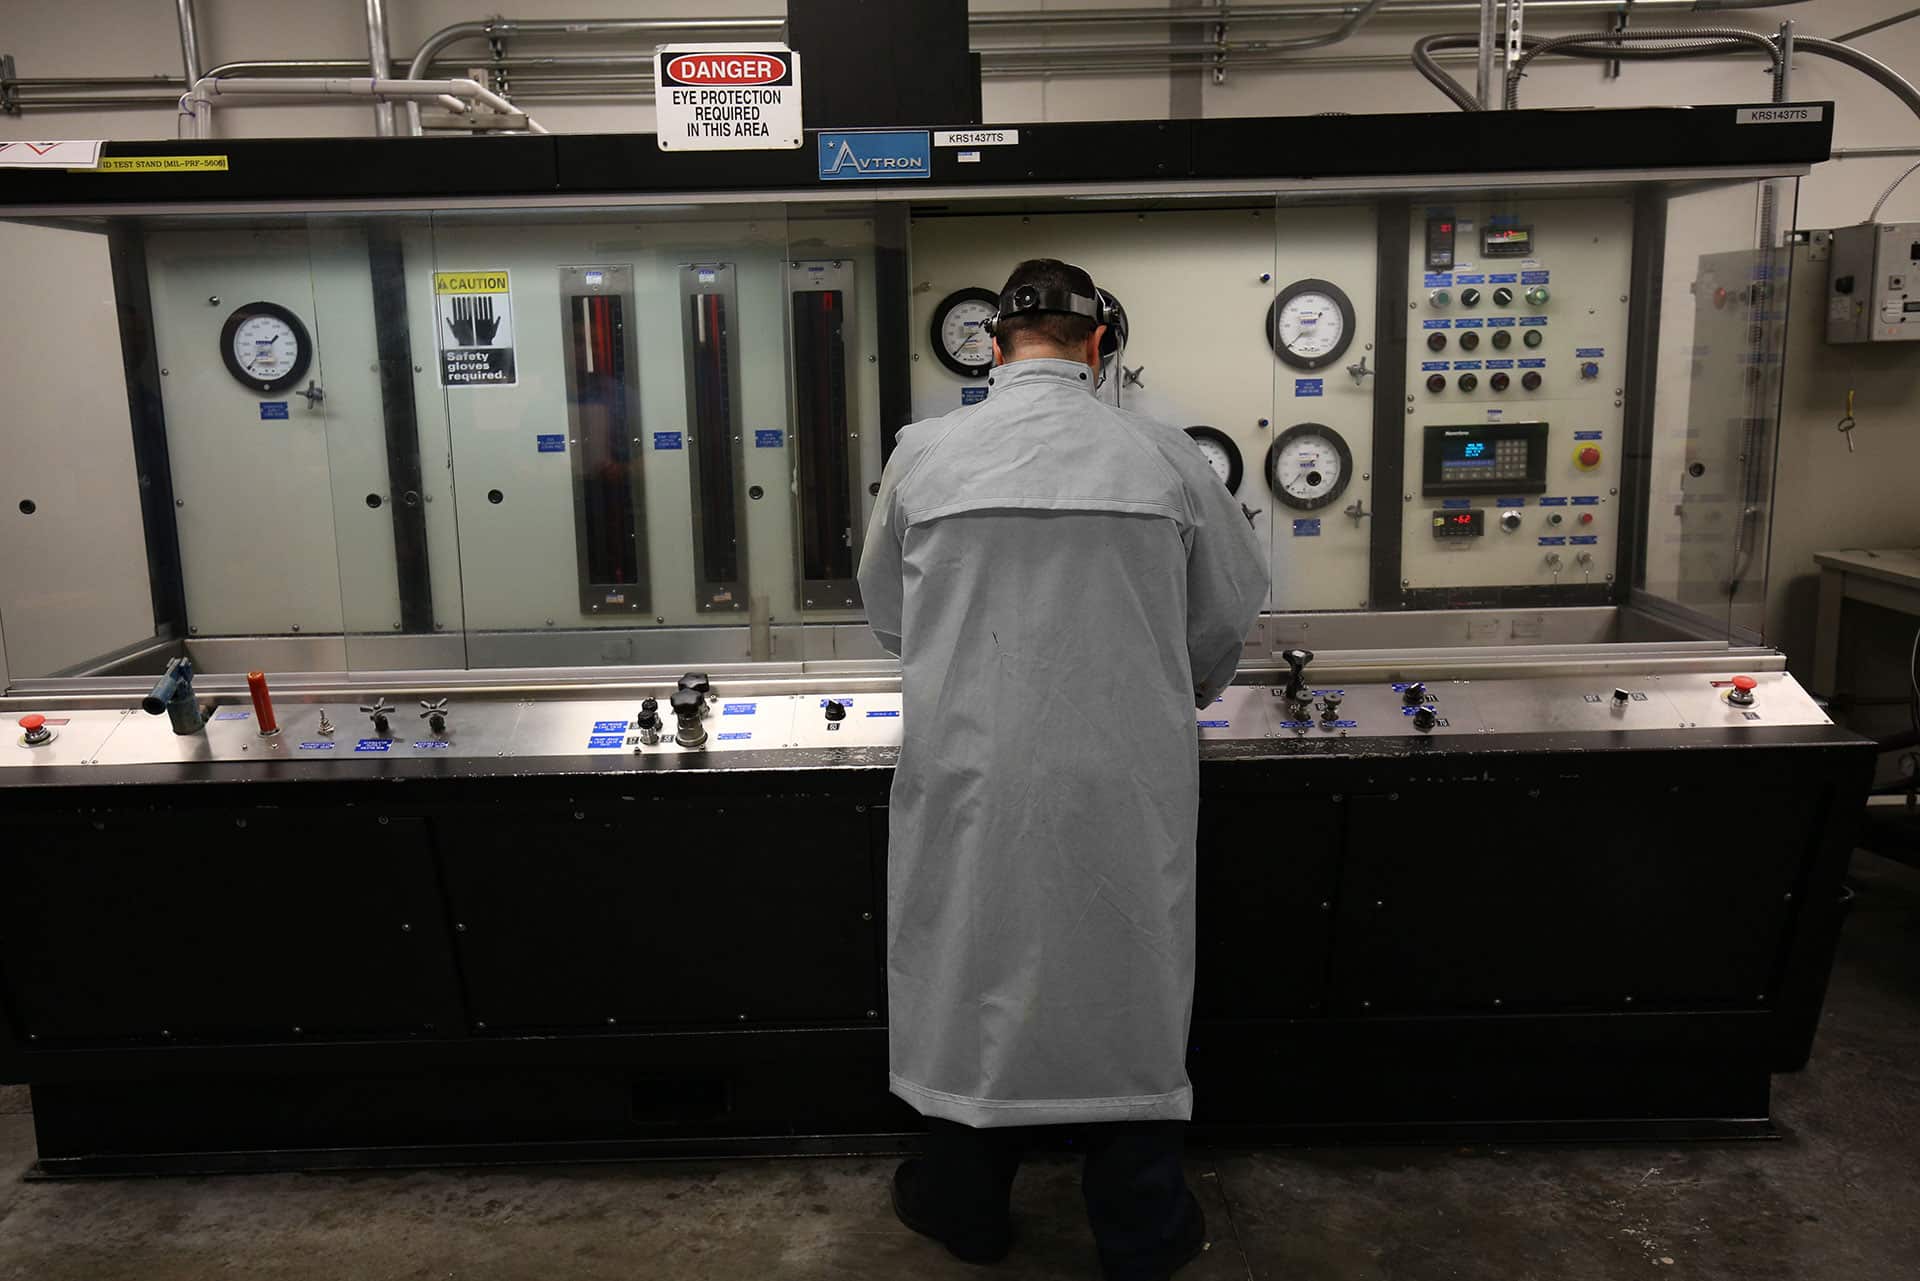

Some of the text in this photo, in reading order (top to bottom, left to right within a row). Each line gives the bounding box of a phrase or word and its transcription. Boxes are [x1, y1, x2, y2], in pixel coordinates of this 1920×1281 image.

[681, 60, 772, 79] DANGER
[672, 89, 781, 105] EYE PROTECTION
[695, 106, 761, 121] REQUIRED
[1751, 109, 1808, 121] KRS1437TS
[687, 122, 769, 137] IN THIS AREA
[949, 133, 1004, 144] KRS1437TS
[825, 139, 923, 174] AVTRON
[114, 160, 133, 169] TEST
[135, 159, 162, 168] STAND
[449, 277, 506, 290] CAUTION
[447, 351, 489, 363] Safety
[447, 361, 490, 373] gloves
[448, 369, 508, 382] required.
